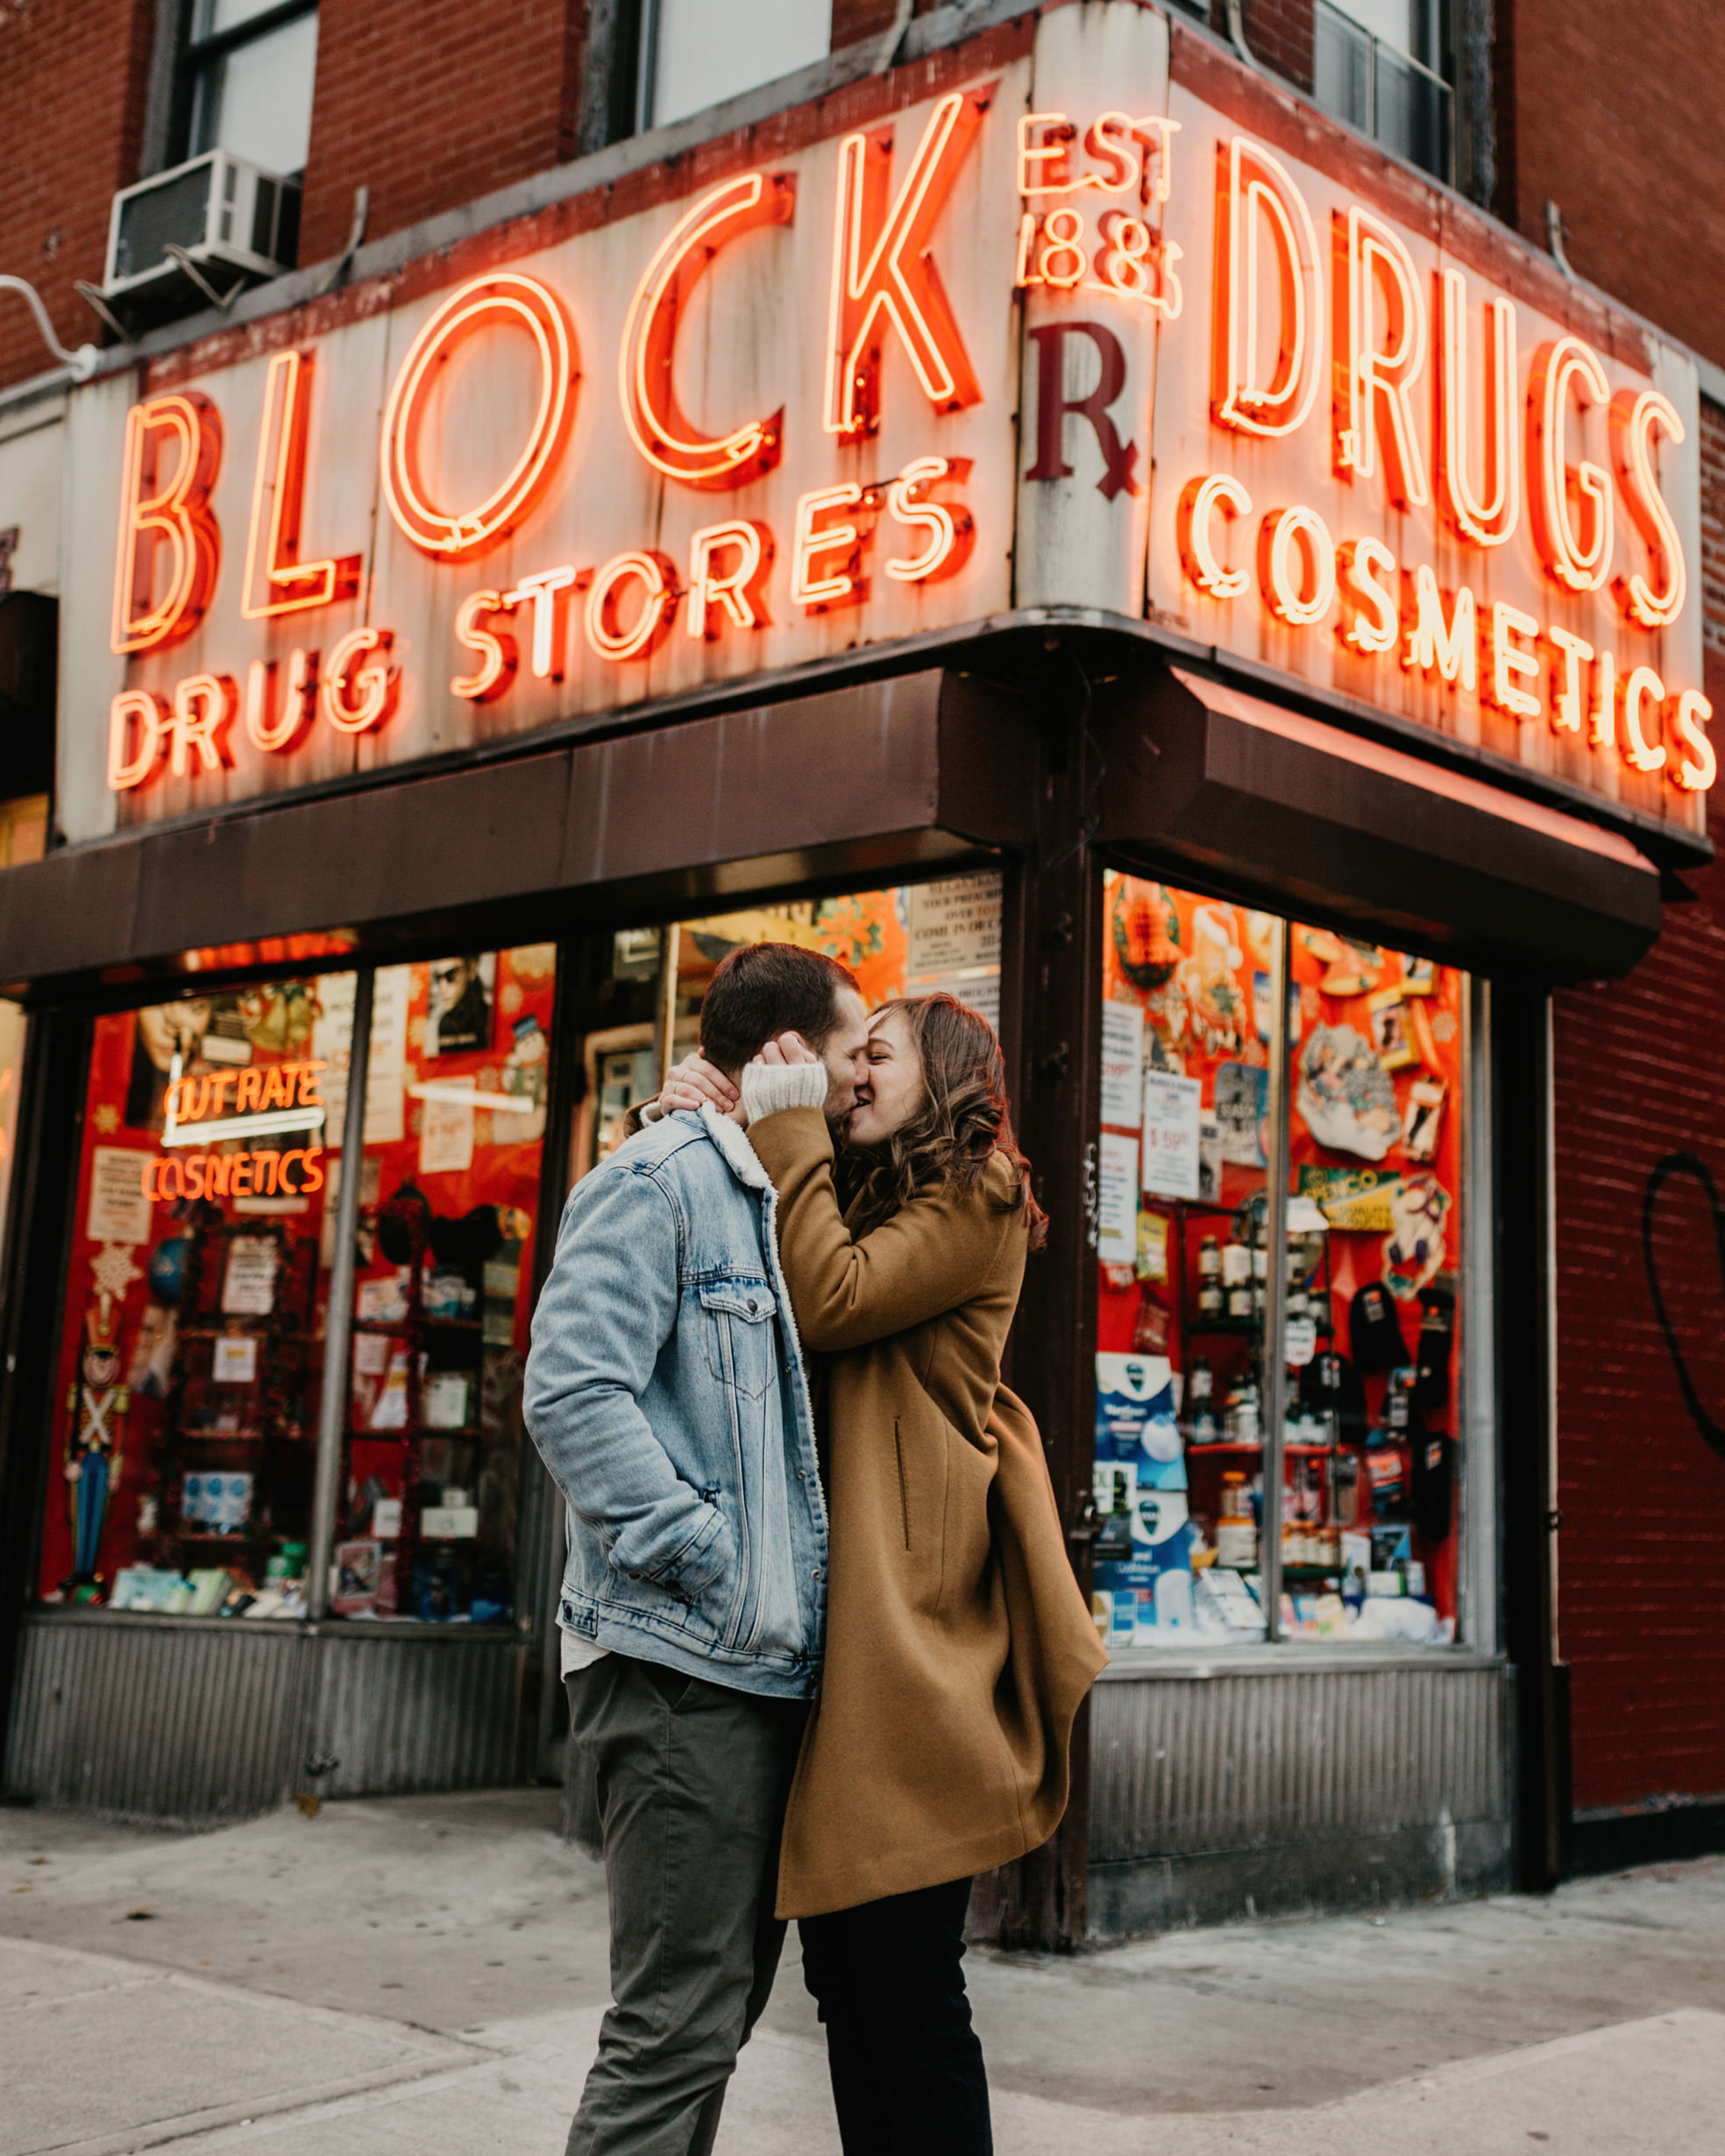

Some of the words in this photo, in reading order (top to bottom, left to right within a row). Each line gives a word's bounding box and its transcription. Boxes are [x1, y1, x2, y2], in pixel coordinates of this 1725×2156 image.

[1015, 207, 1184, 319] 1885
[1016, 110, 1182, 202] EST
[110, 86, 992, 656] BLOCK
[1210, 135, 1688, 628] DRUGS
[107, 628, 401, 791] DRUG
[450, 456, 975, 701] STORES
[1177, 472, 1717, 792] COSMETICS
[140, 1146, 324, 1202] COSMETICS
[236, 1060, 329, 1113] RATE
